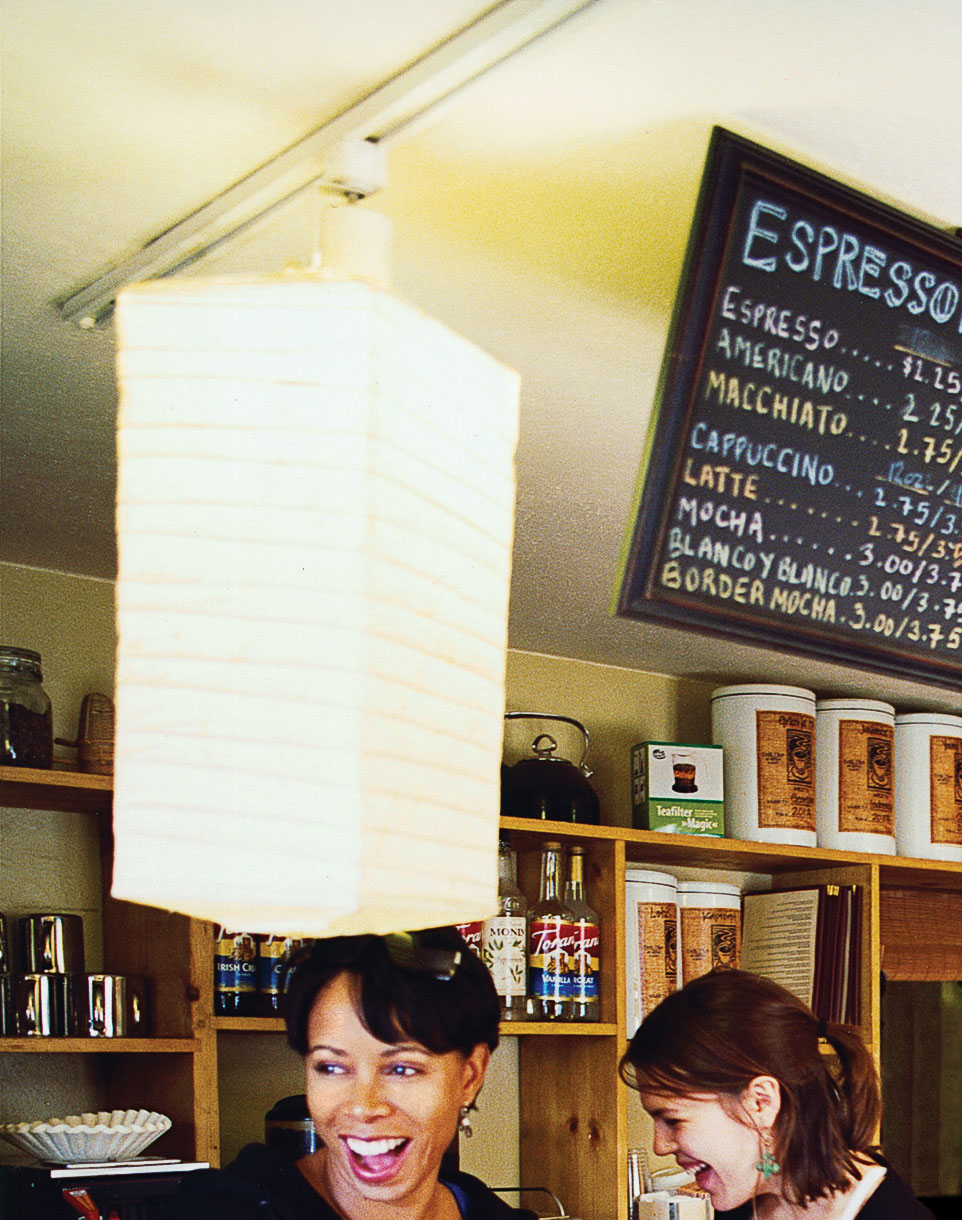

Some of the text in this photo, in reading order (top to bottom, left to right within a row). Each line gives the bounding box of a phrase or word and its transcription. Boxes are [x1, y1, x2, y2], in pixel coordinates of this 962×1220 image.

[743, 200, 959, 324] ESPRESSO
[721, 286, 840, 351] ESPRESSO
[717, 328, 849, 393] AMERICANO
[704, 370, 848, 436] MACCHIATO
[683, 458, 760, 501] LATTE
[691, 422, 835, 487] CAPPUCCINO
[679, 496, 764, 543] MOCHA
[669, 527, 756, 570] BLANCO
[758, 550, 775, 579] Y
[661, 561, 765, 606] BORDER
[769, 585, 836, 624] MOCHA
[656, 805, 694, 818] Teafilter
